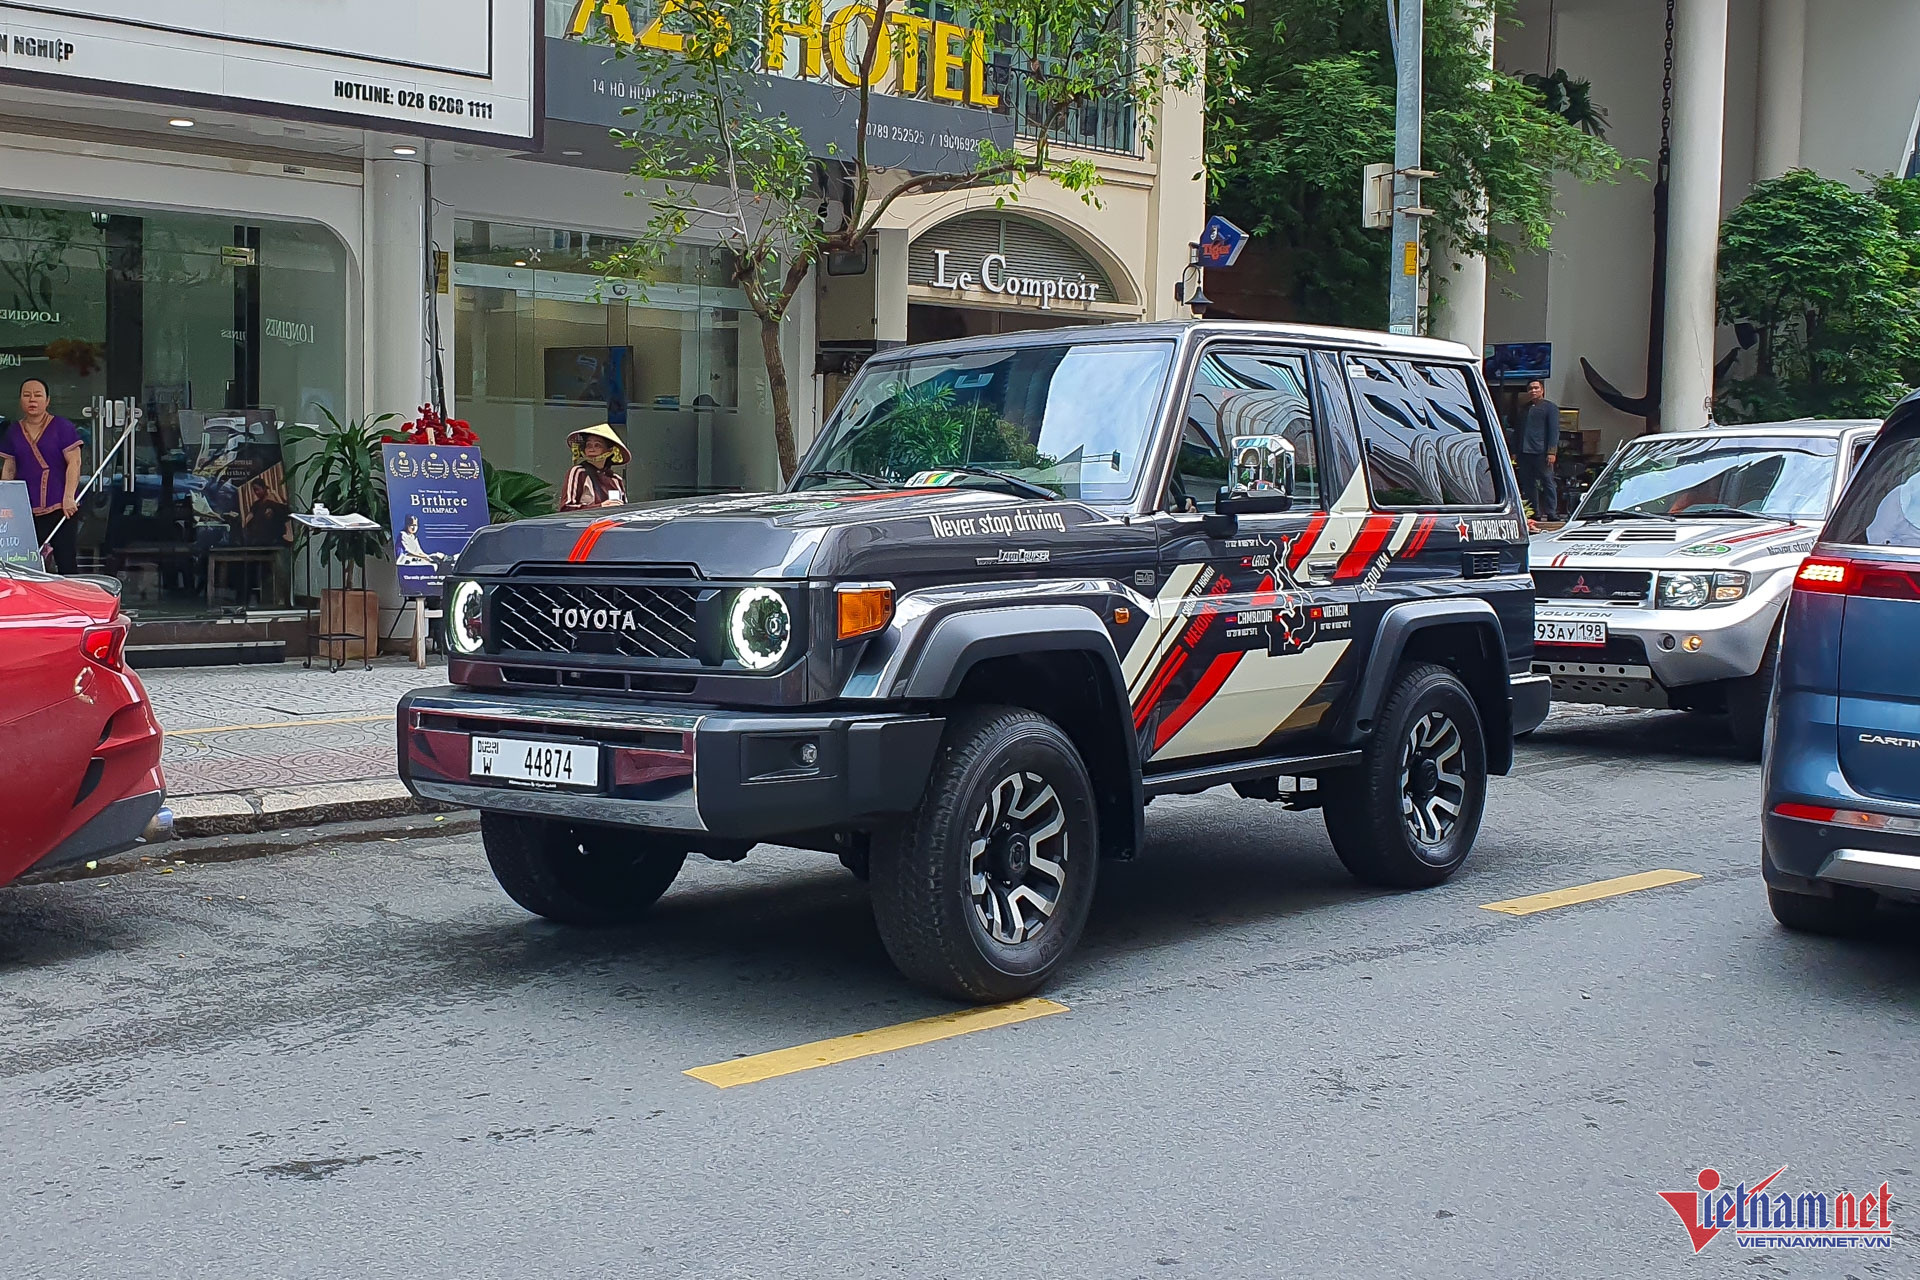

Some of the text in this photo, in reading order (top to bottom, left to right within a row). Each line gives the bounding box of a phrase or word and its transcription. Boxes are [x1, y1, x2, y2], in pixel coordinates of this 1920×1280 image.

[13, 35, 75, 62] NGHIỆP
[765, 0, 1000, 108] HOTEL
[592, 78, 605, 94] 14
[334, 80, 394, 105] HOTLINE:
[397, 89, 425, 109] 028
[467, 101, 493, 119] 1111
[866, 121, 889, 139] 0789
[892, 126, 925, 145] 252525
[931, 249, 1099, 309] Le Comptoir
[410, 494, 468, 507] Birthree
[929, 509, 1066, 538] Never stop driving
[1471, 519, 1520, 541] NACHAL'STVO
[1251, 554, 1271, 567] LAOS
[1361, 551, 1391, 596] 2500 KM
[552, 607, 637, 631] TOYOTA
[1237, 610, 1273, 625] CAMBODIA
[1321, 604, 1349, 618] VIETNAM
[1183, 602, 1219, 649] MEKONG
[1578, 624, 1603, 637] 198
[482, 747, 572, 780] W 44874
